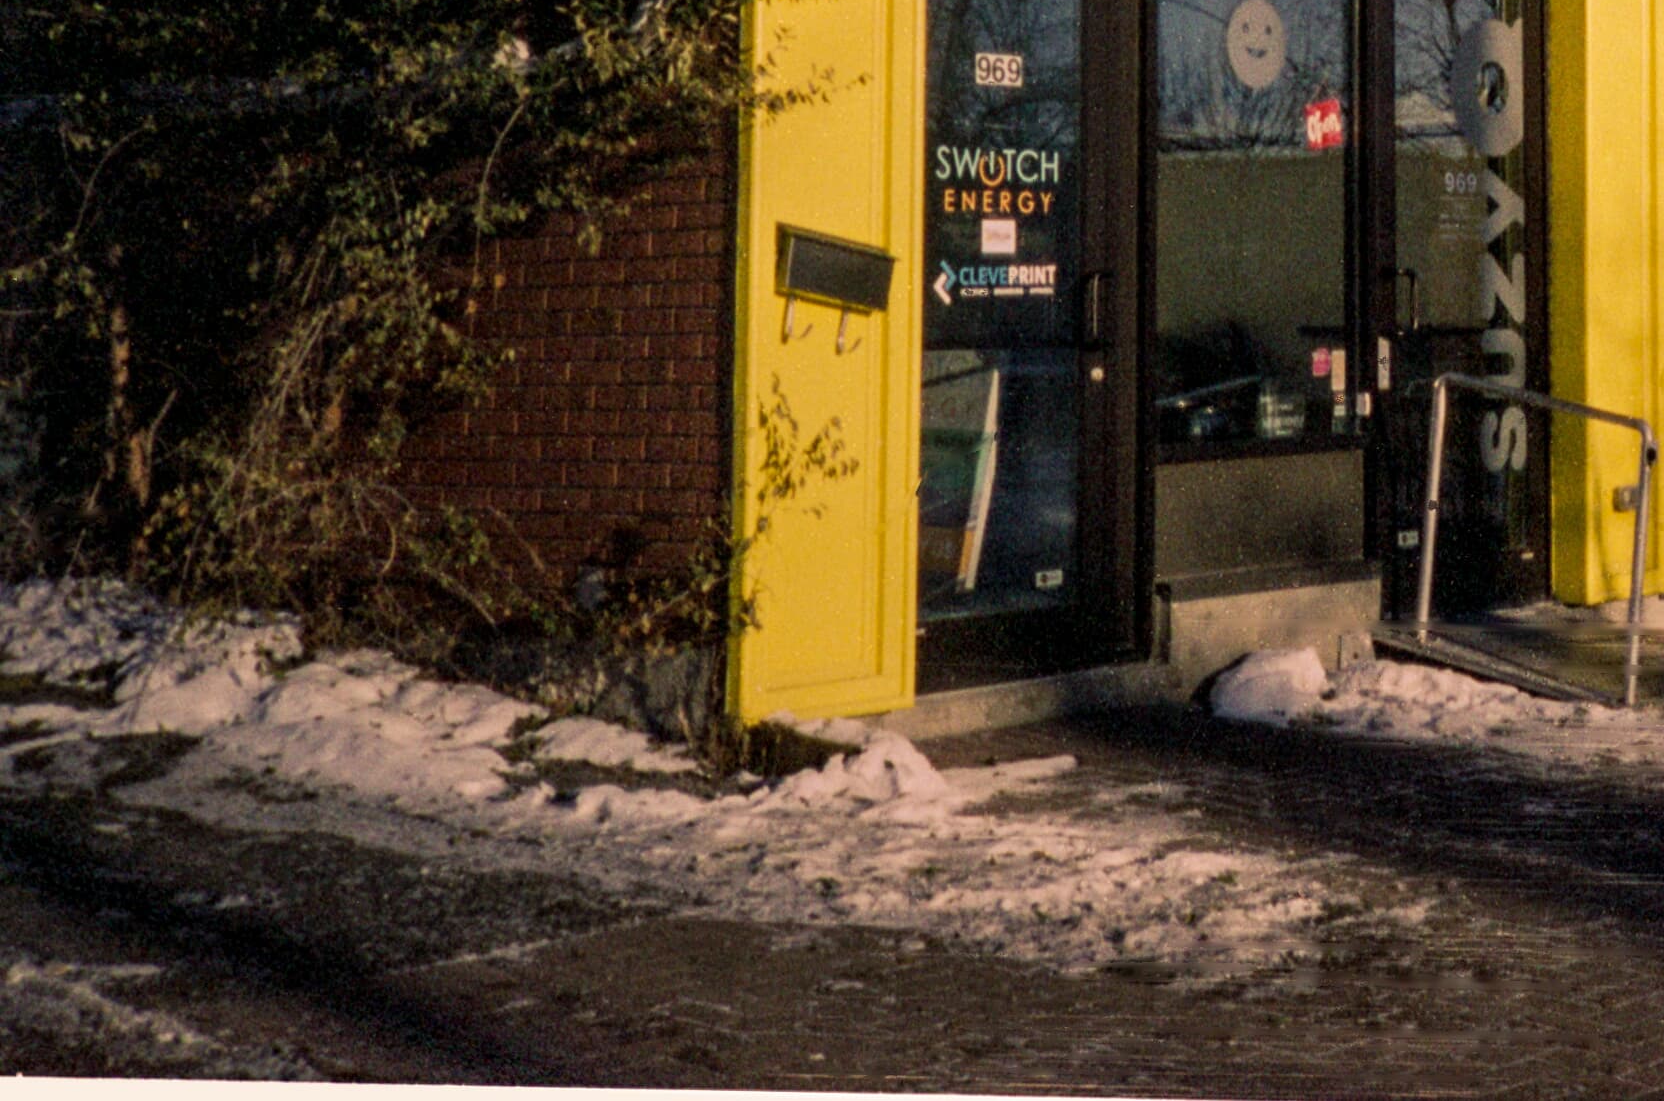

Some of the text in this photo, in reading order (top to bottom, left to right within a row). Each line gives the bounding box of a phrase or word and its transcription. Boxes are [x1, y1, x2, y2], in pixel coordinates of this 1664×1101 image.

[977, 55, 1021, 83] 969
[936, 145, 1059, 186] SWITCH
[1444, 171, 1477, 194] 969
[944, 189, 1053, 214] ENERGY
[959, 264, 1057, 286] CLEVEPRINT
